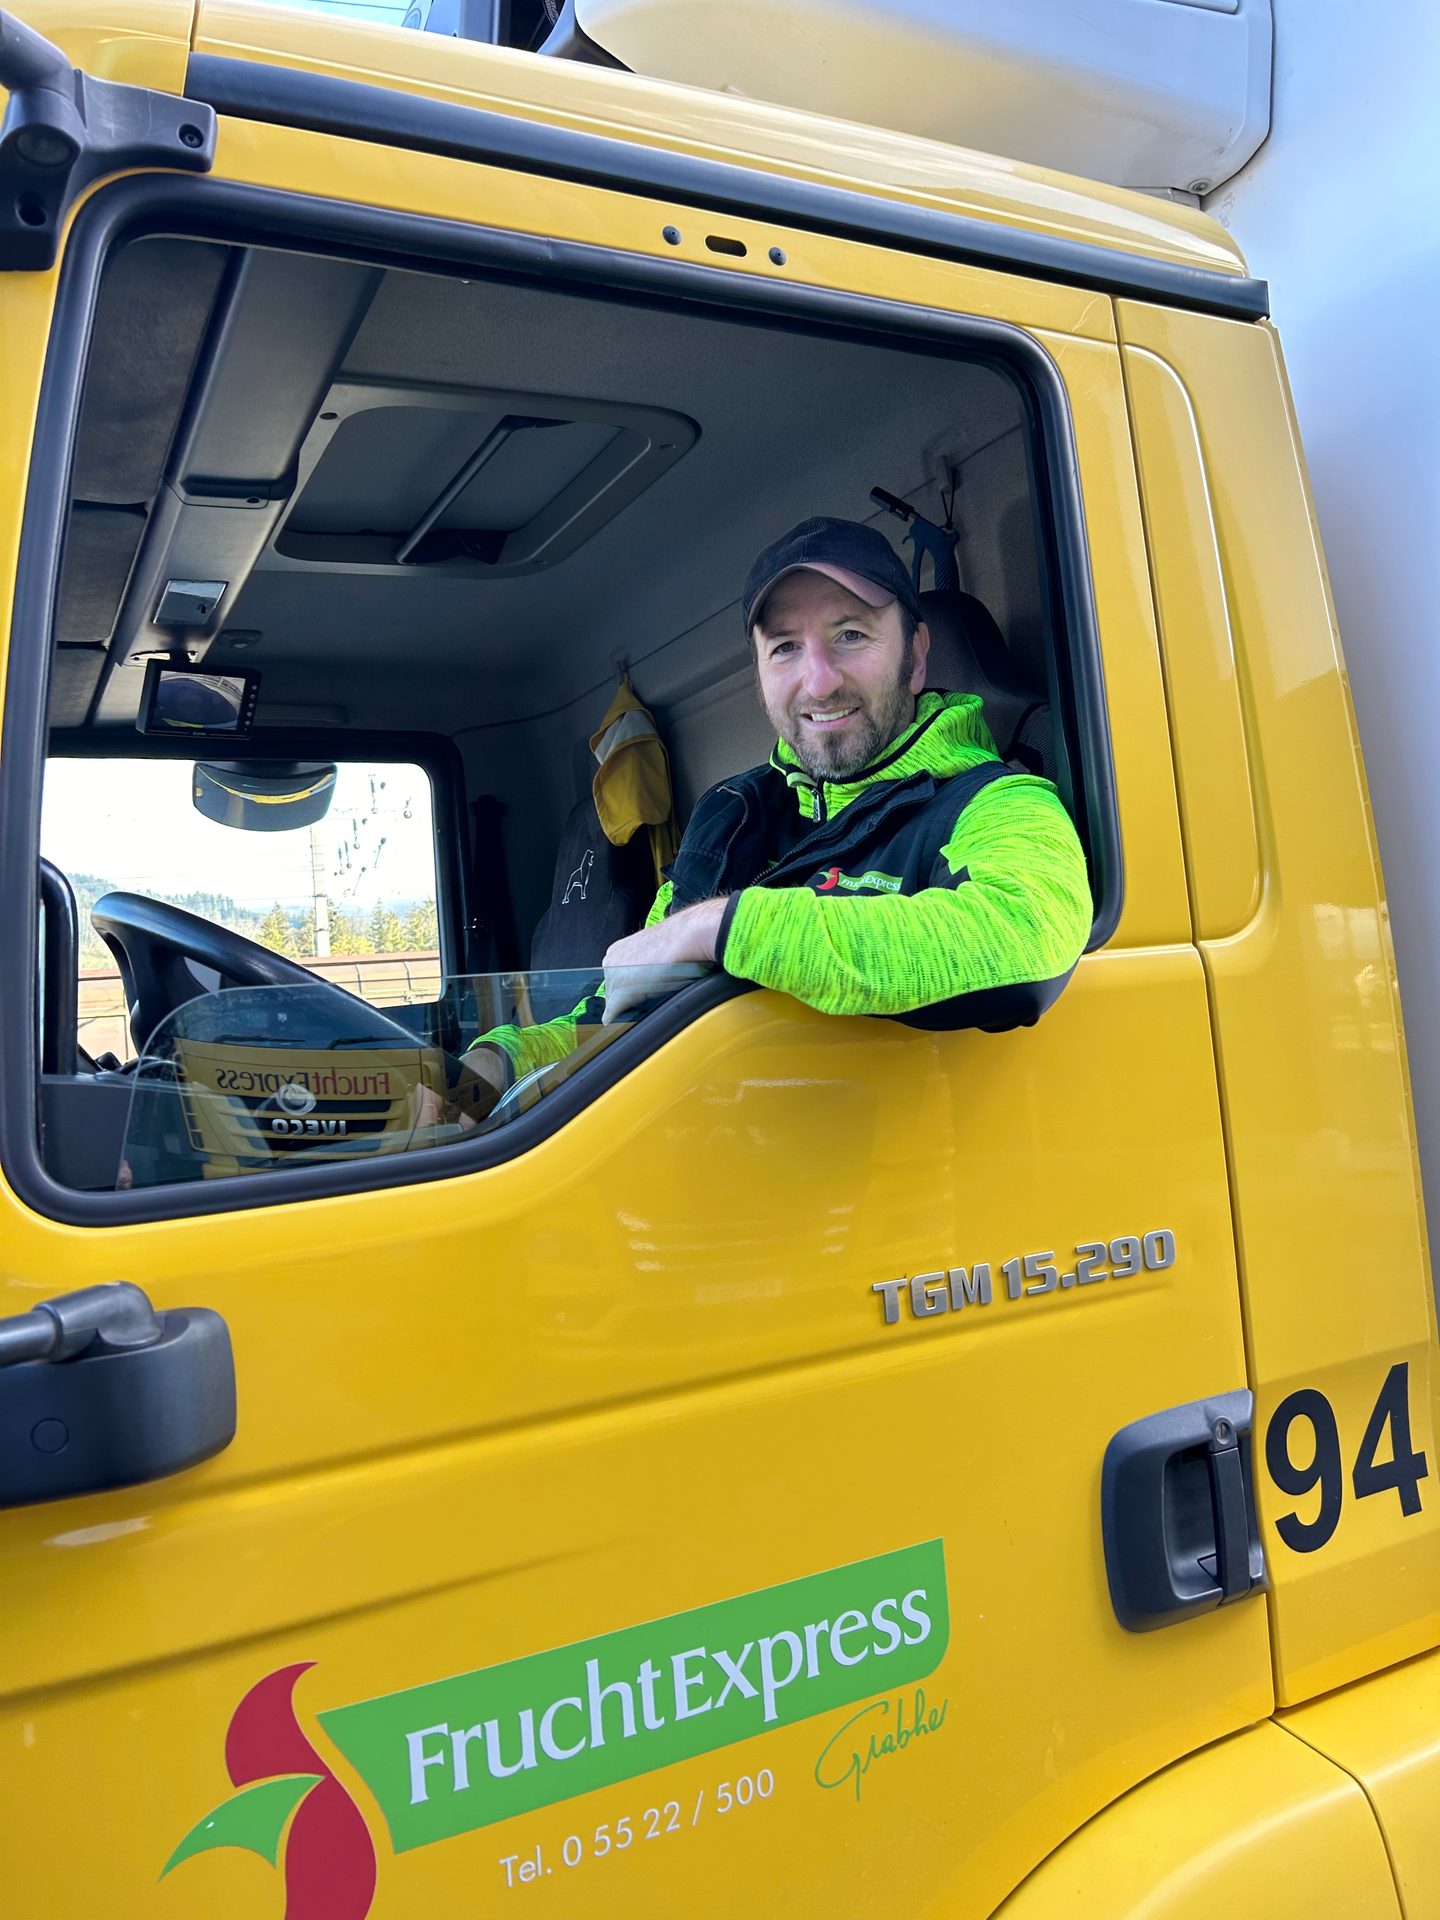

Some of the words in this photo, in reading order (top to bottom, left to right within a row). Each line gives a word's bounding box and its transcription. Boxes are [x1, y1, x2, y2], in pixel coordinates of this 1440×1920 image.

[872, 1263, 992, 1323] TGM
[1002, 1229, 1176, 1298] 15.290
[1265, 1361, 1429, 1553] 94
[405, 1589, 932, 1805] FruchtExpress
[499, 1844, 552, 1888] Tel.
[562, 1835, 583, 1867] 0
[716, 1768, 774, 1813] 500
